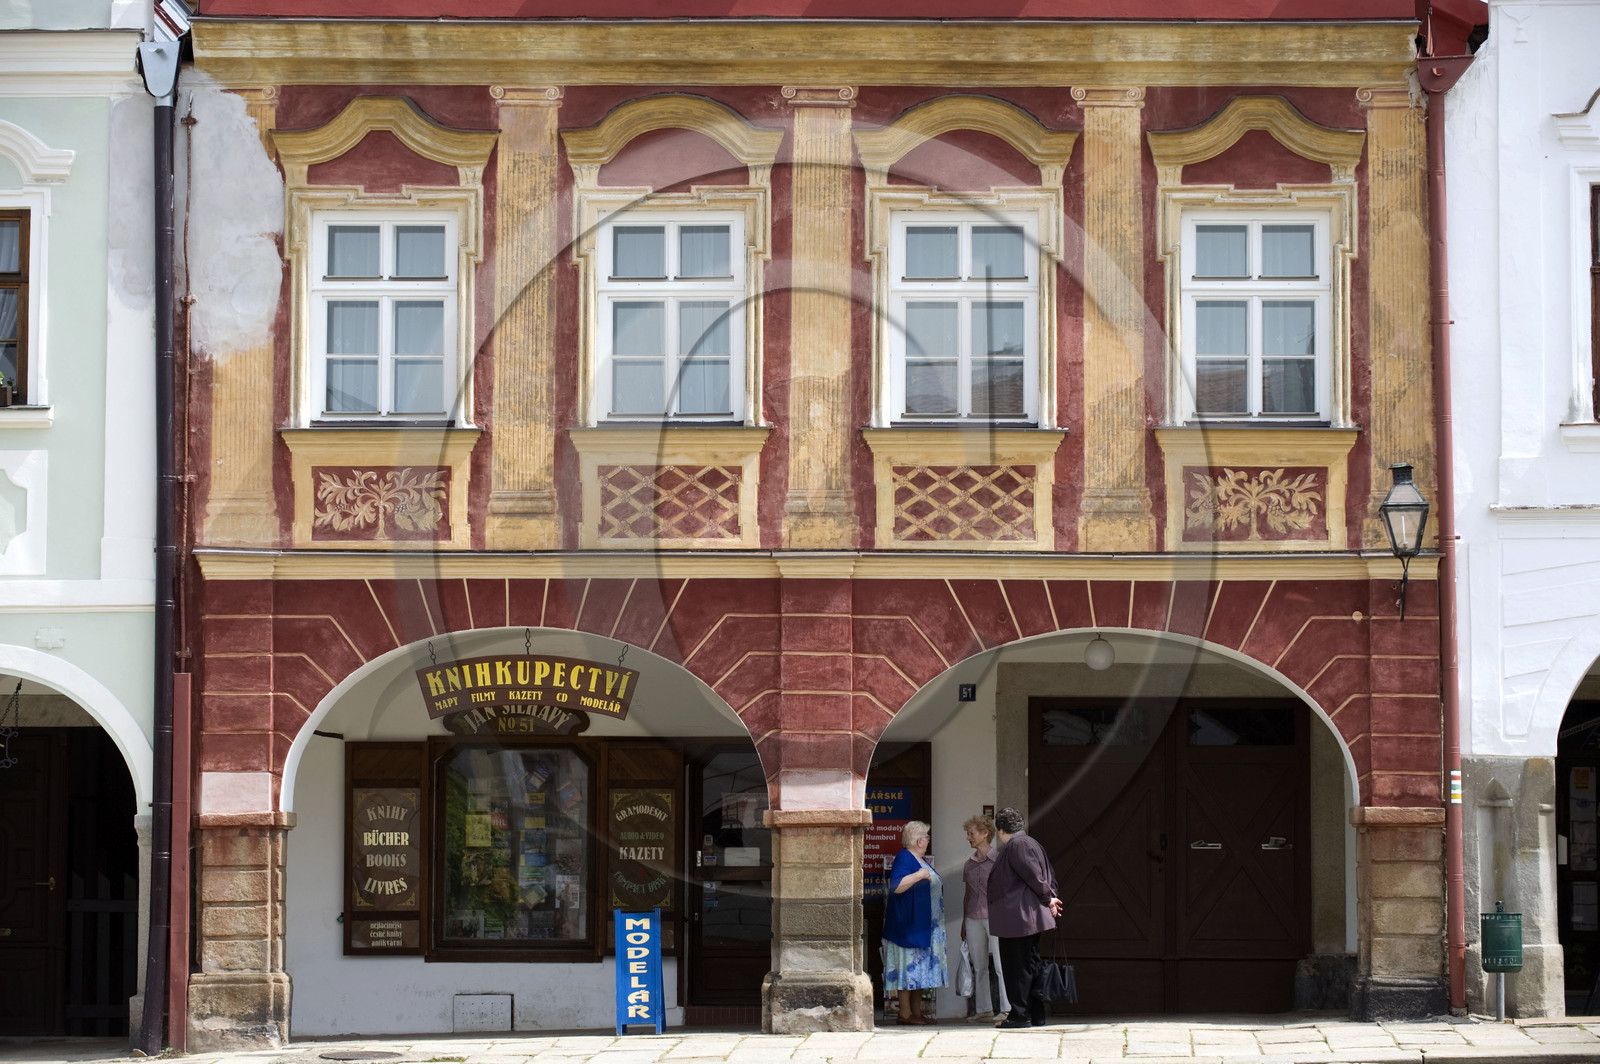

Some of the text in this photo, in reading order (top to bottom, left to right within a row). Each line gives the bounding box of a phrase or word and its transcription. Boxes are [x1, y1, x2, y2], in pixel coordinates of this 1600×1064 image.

[425, 661, 632, 699] KNIHKUPECTVÍ
[962, 687, 972, 698] 51
[435, 691, 622, 713] MAPY FILMY KAZETY CD MODELÁŘ
[463, 706, 497, 734] JAN
[520, 717, 534, 732] 51
[865, 790, 904, 800] LÁŘSKÉ
[366, 805, 408, 821] KNIHY
[615, 804, 668, 821] GRAMODESKY
[363, 829, 409, 846] BÜCHER
[620, 831, 639, 840] AUDIO
[645, 831, 664, 840] VIDEO
[366, 853, 407, 867] BOOKS
[619, 846, 665, 860] KAZETY
[363, 877, 408, 895] LIVRES
[613, 871, 646, 894] COMPACT
